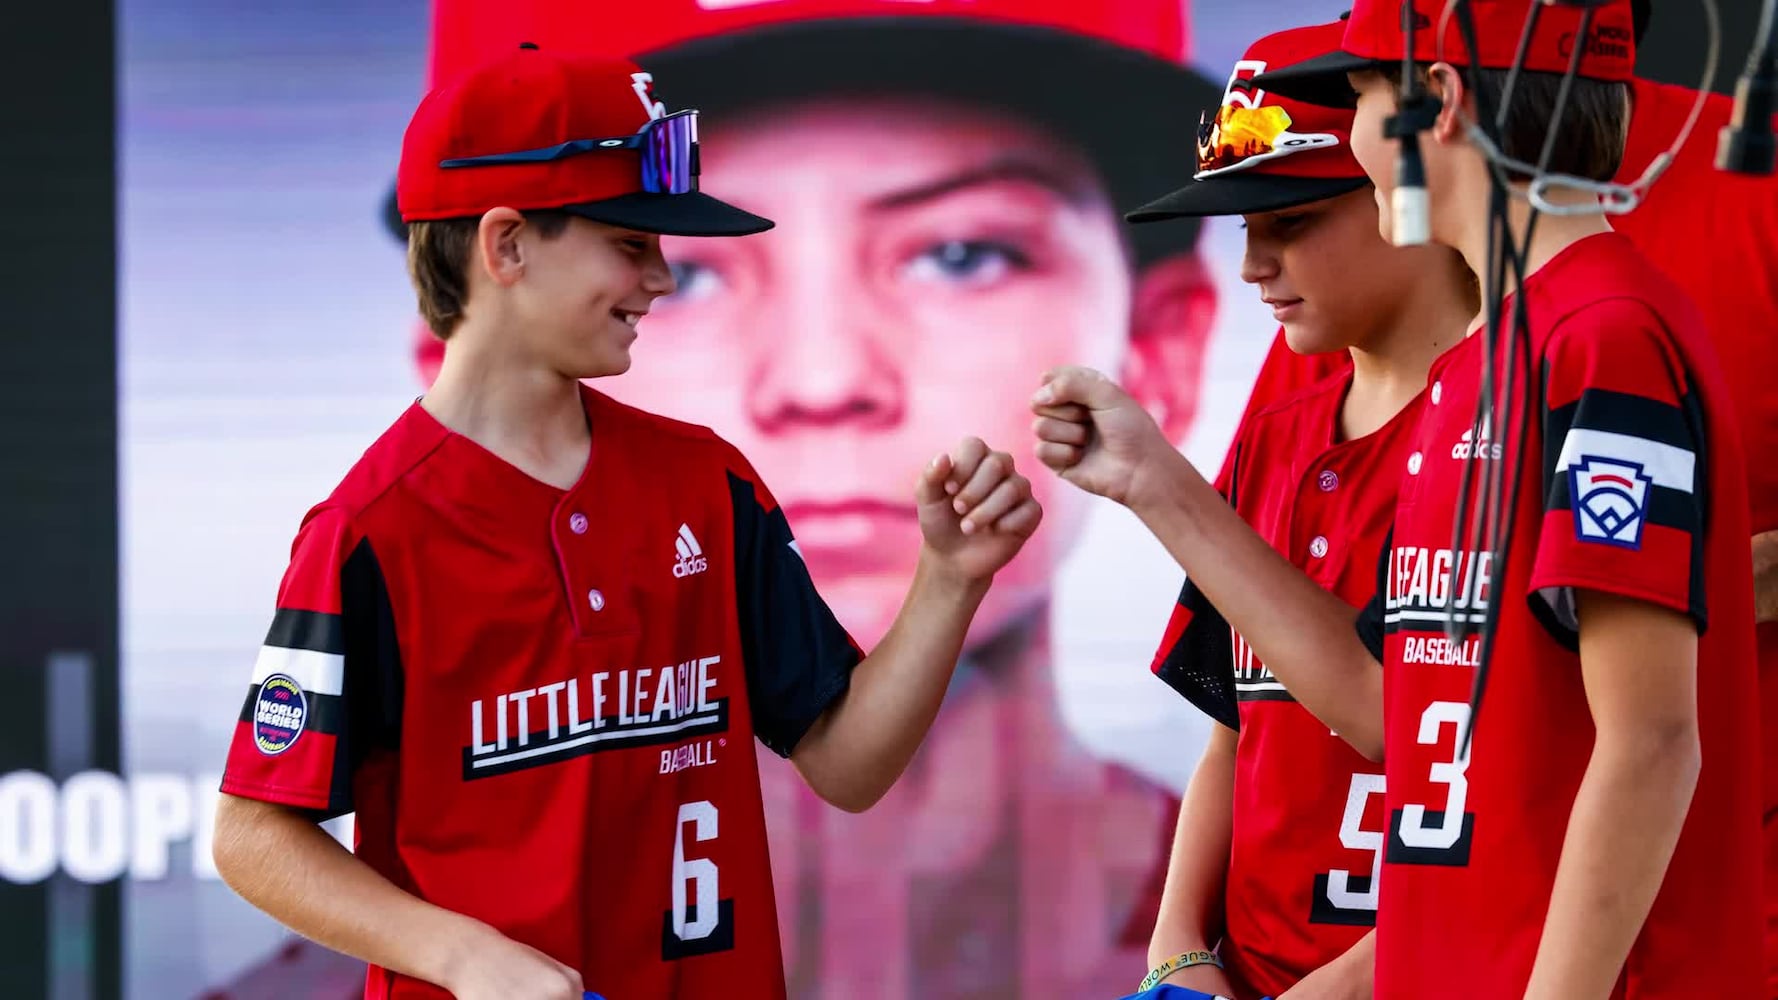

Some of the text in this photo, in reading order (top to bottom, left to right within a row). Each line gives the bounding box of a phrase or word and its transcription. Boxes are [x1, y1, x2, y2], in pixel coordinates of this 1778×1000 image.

[1452, 440, 1503, 460] addas
[257, 711, 301, 730] SERIES
[259, 699, 302, 719] WORLD
[472, 655, 721, 757] LITTLE LEAGUE
[1398, 701, 1473, 849] 3
[672, 800, 719, 941] 6
[1326, 773, 1387, 911] 5
